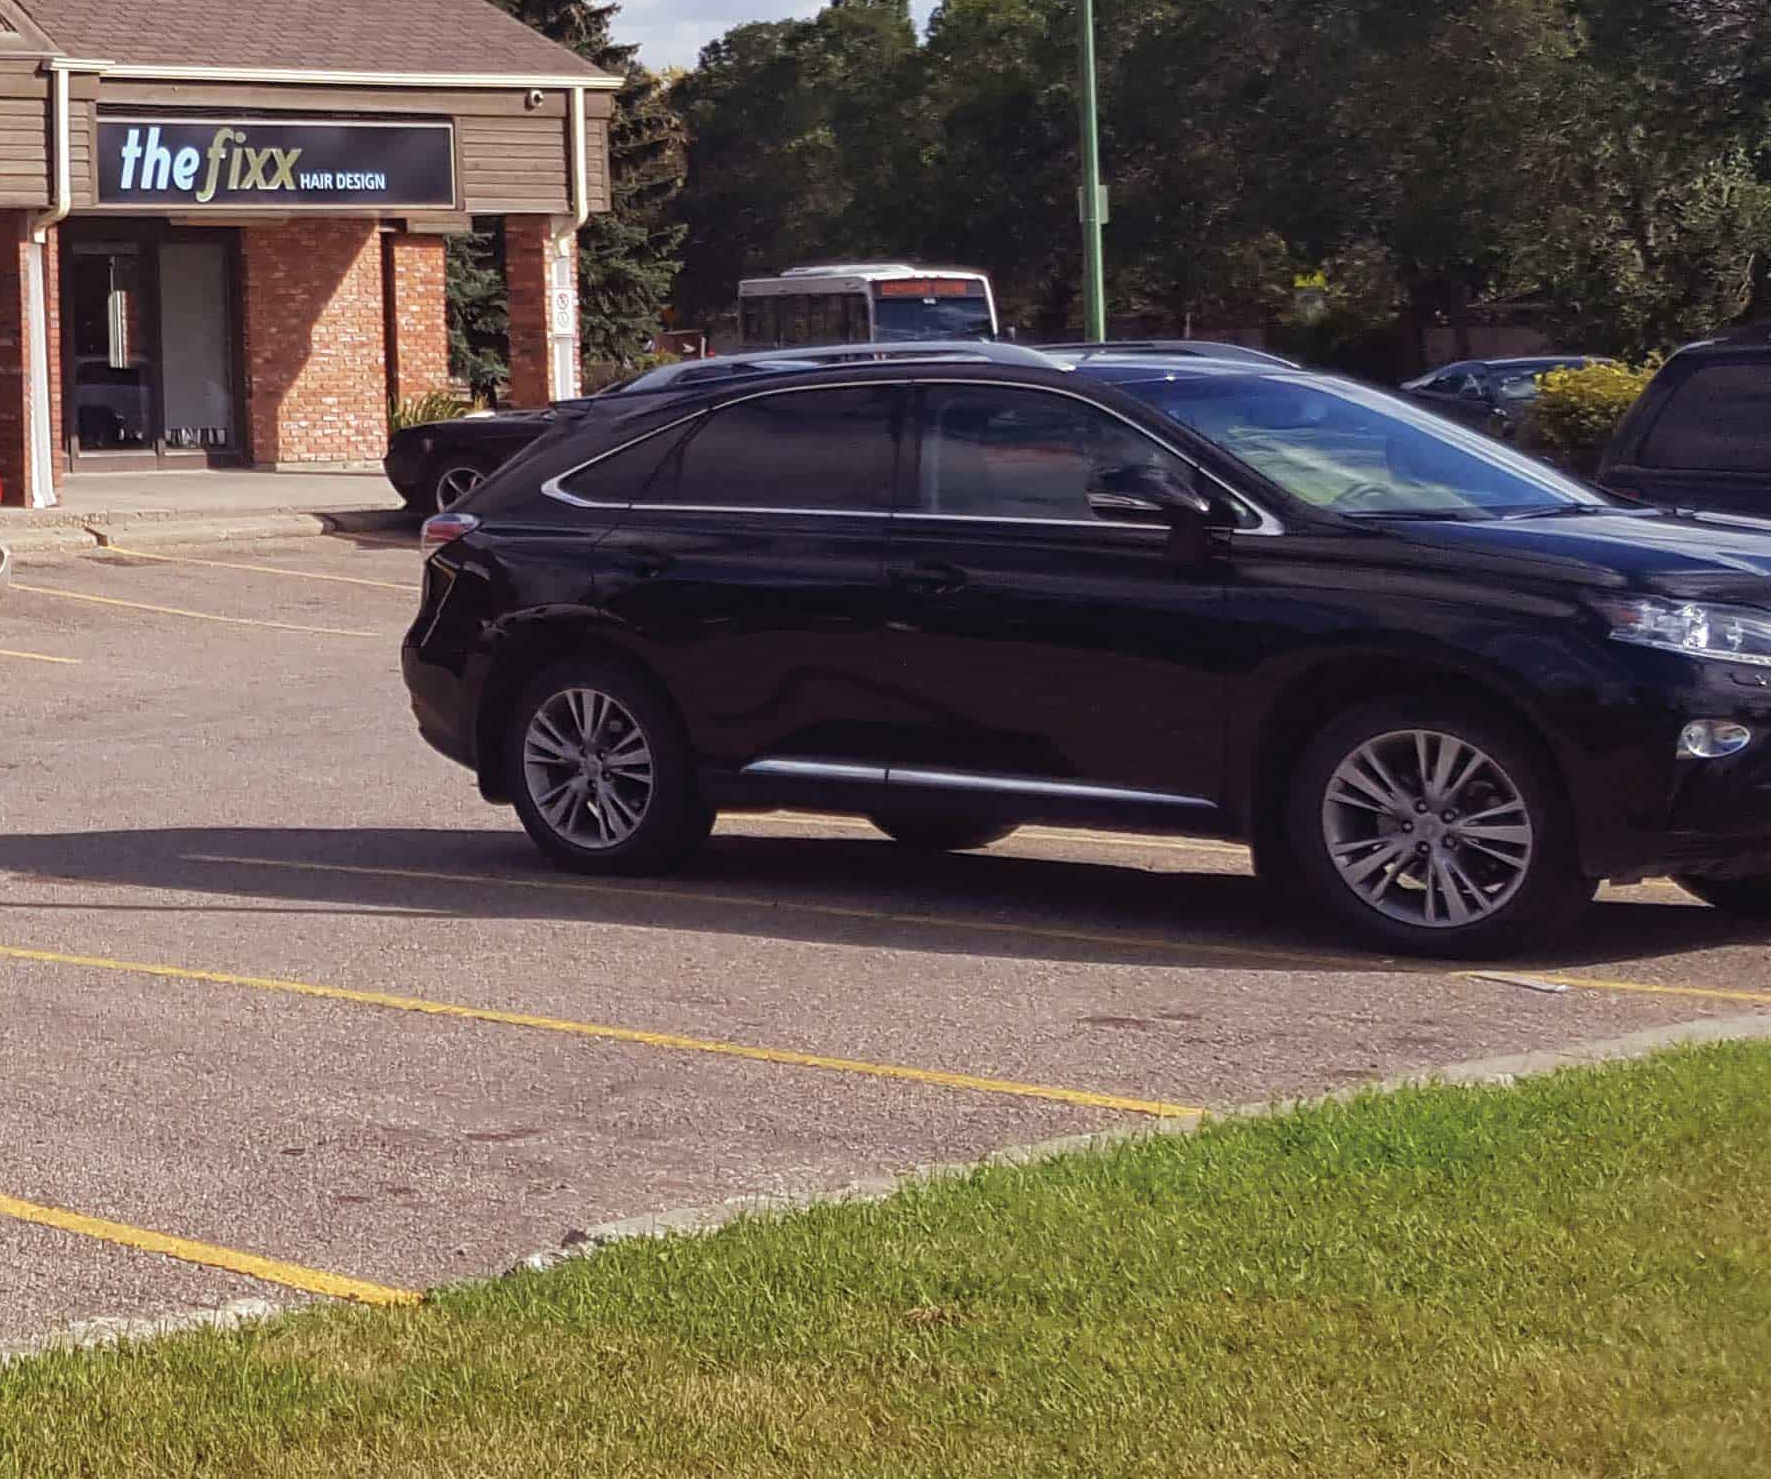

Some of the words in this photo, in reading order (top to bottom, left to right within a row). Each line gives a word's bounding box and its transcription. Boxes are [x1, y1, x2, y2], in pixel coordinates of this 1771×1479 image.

[120, 127, 200, 190] the
[196, 128, 302, 202] fixx
[300, 173, 333, 190] HAIR
[337, 173, 385, 190] DESIGN
